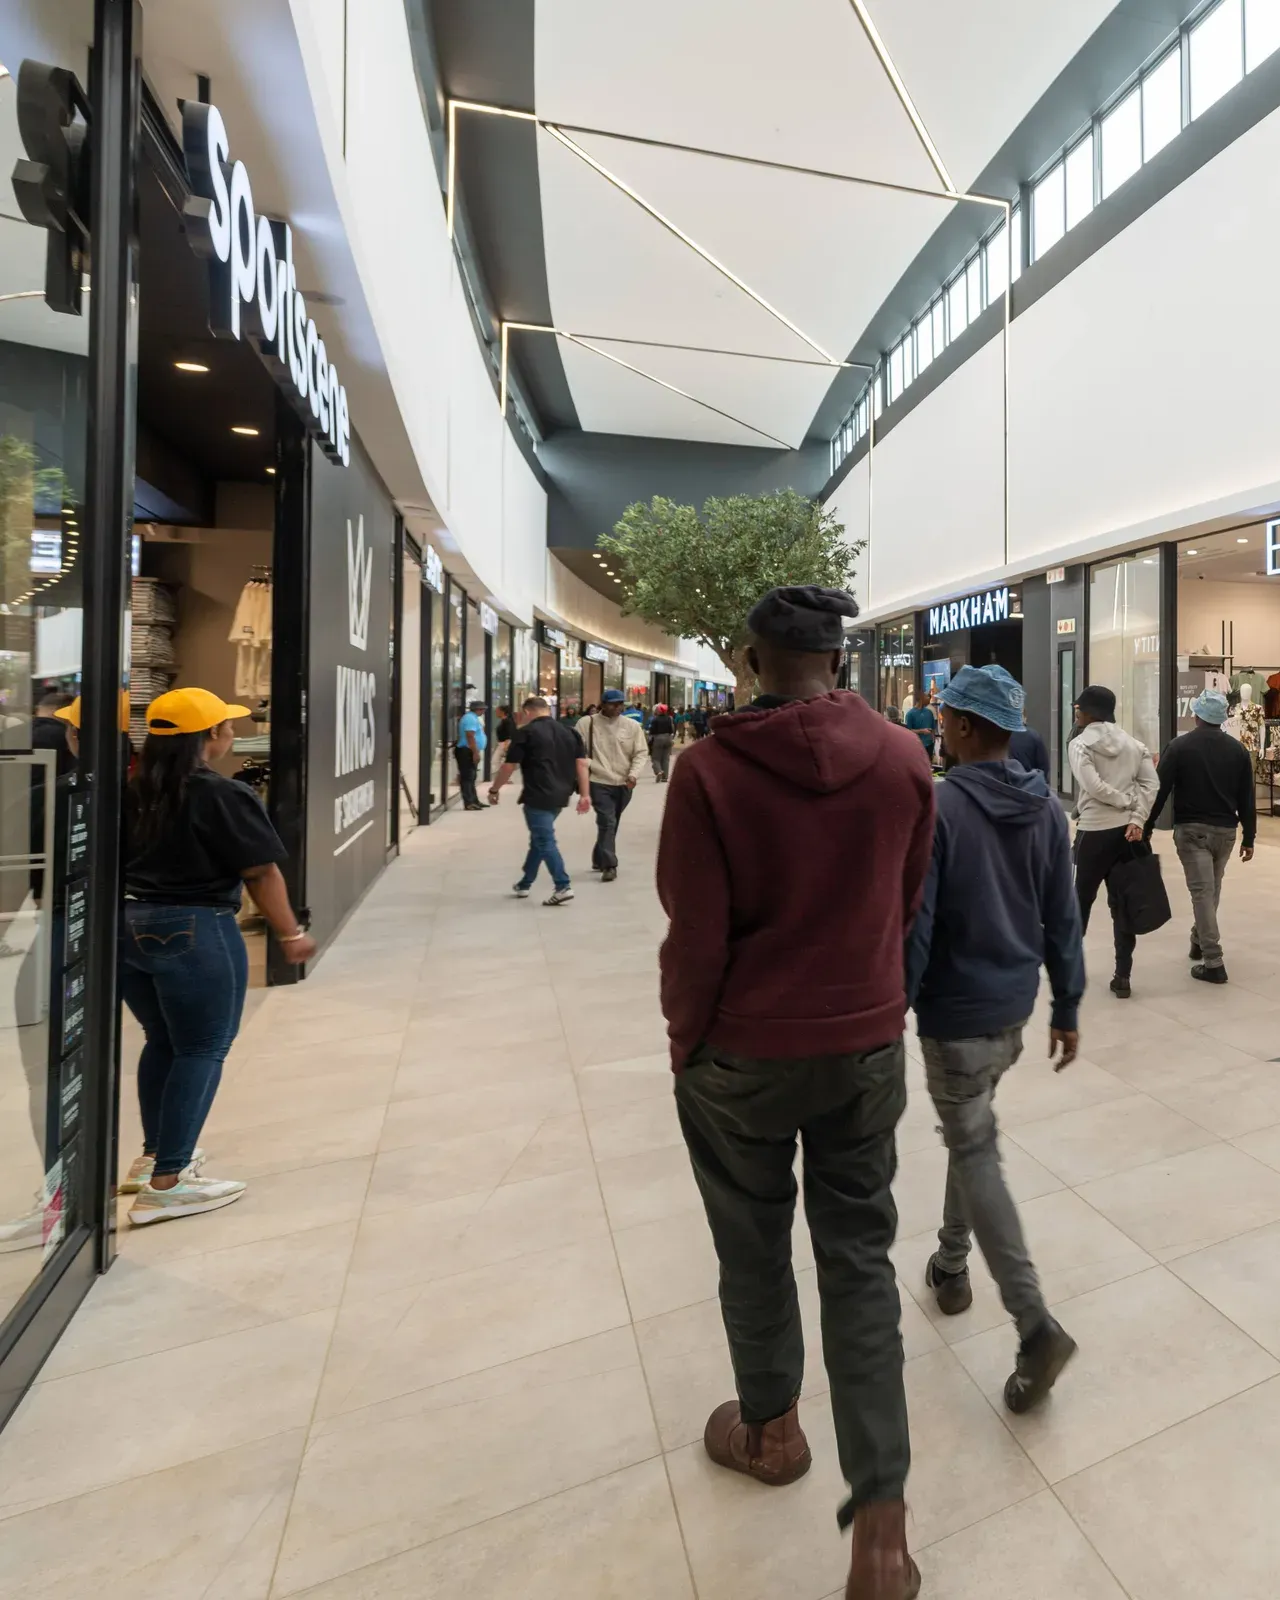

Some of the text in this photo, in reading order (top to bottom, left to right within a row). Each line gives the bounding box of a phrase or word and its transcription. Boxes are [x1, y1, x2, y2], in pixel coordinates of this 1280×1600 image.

[207, 104, 350, 467] sportscene
[929, 587, 1009, 635] MARKHAM
[335, 665, 376, 777] KINGS
